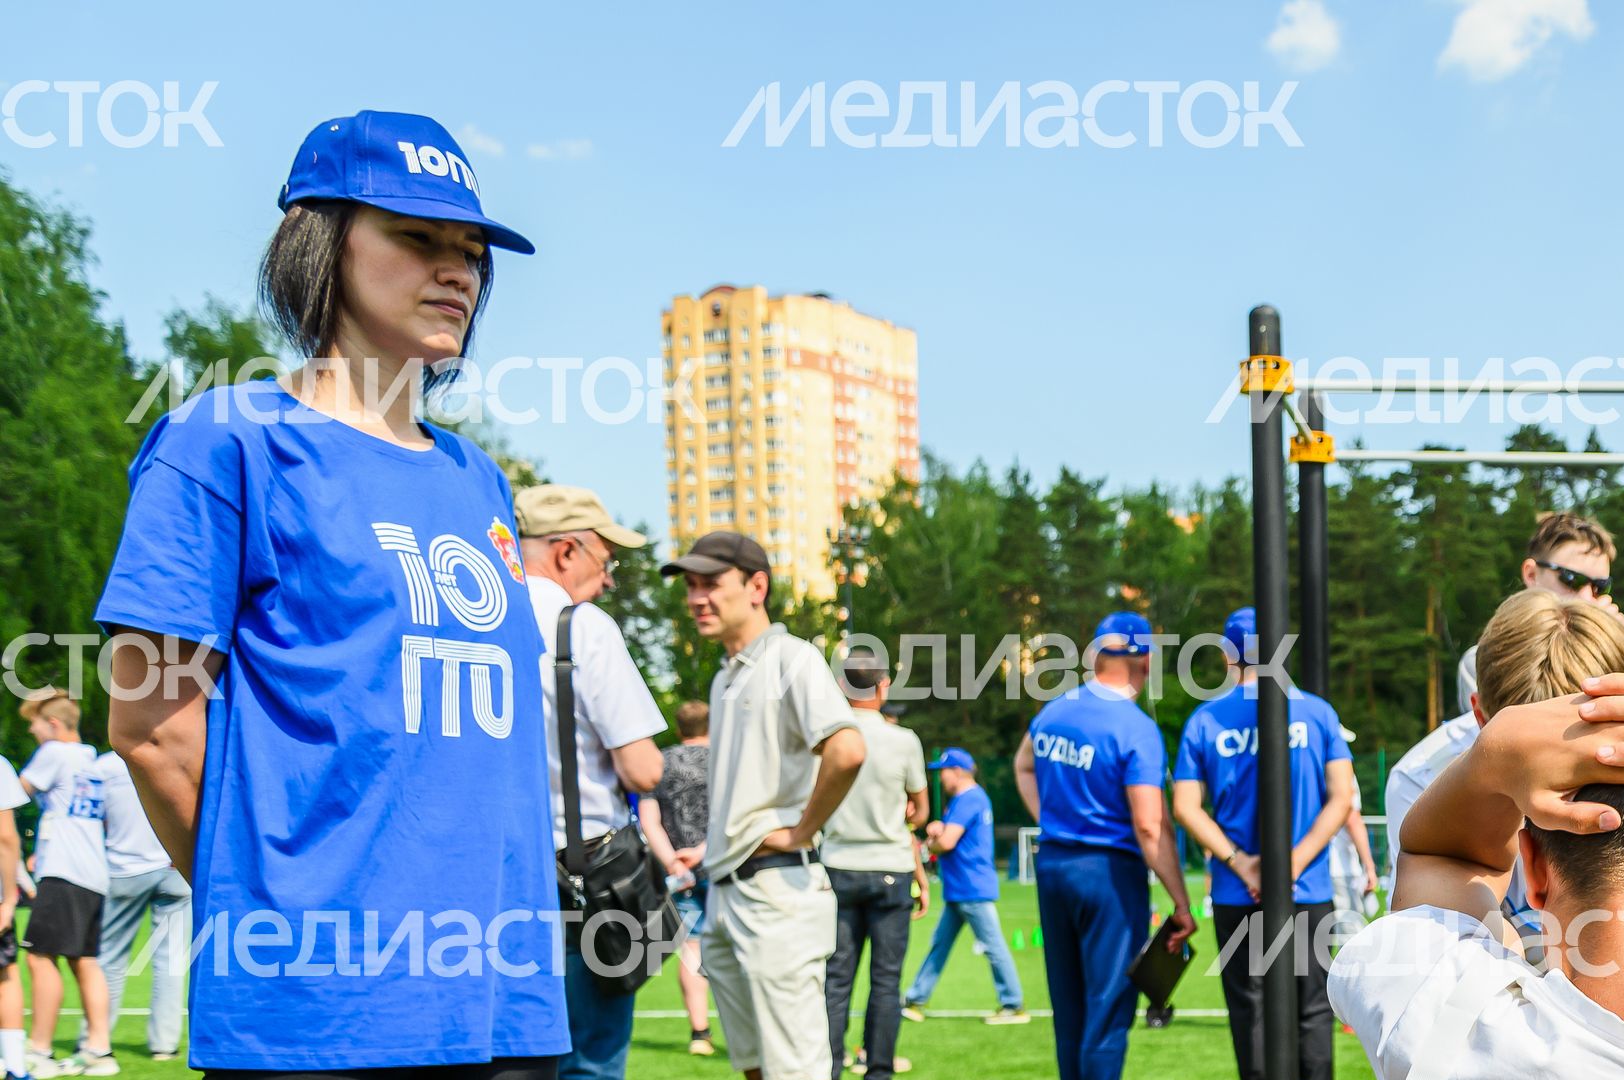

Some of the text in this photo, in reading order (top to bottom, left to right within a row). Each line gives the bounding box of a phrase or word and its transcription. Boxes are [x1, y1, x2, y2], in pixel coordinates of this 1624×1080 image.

[401, 634, 514, 740] ГТО
[1033, 731, 1096, 771] СУДЬЯ
[1215, 721, 1308, 758] СУЯ
